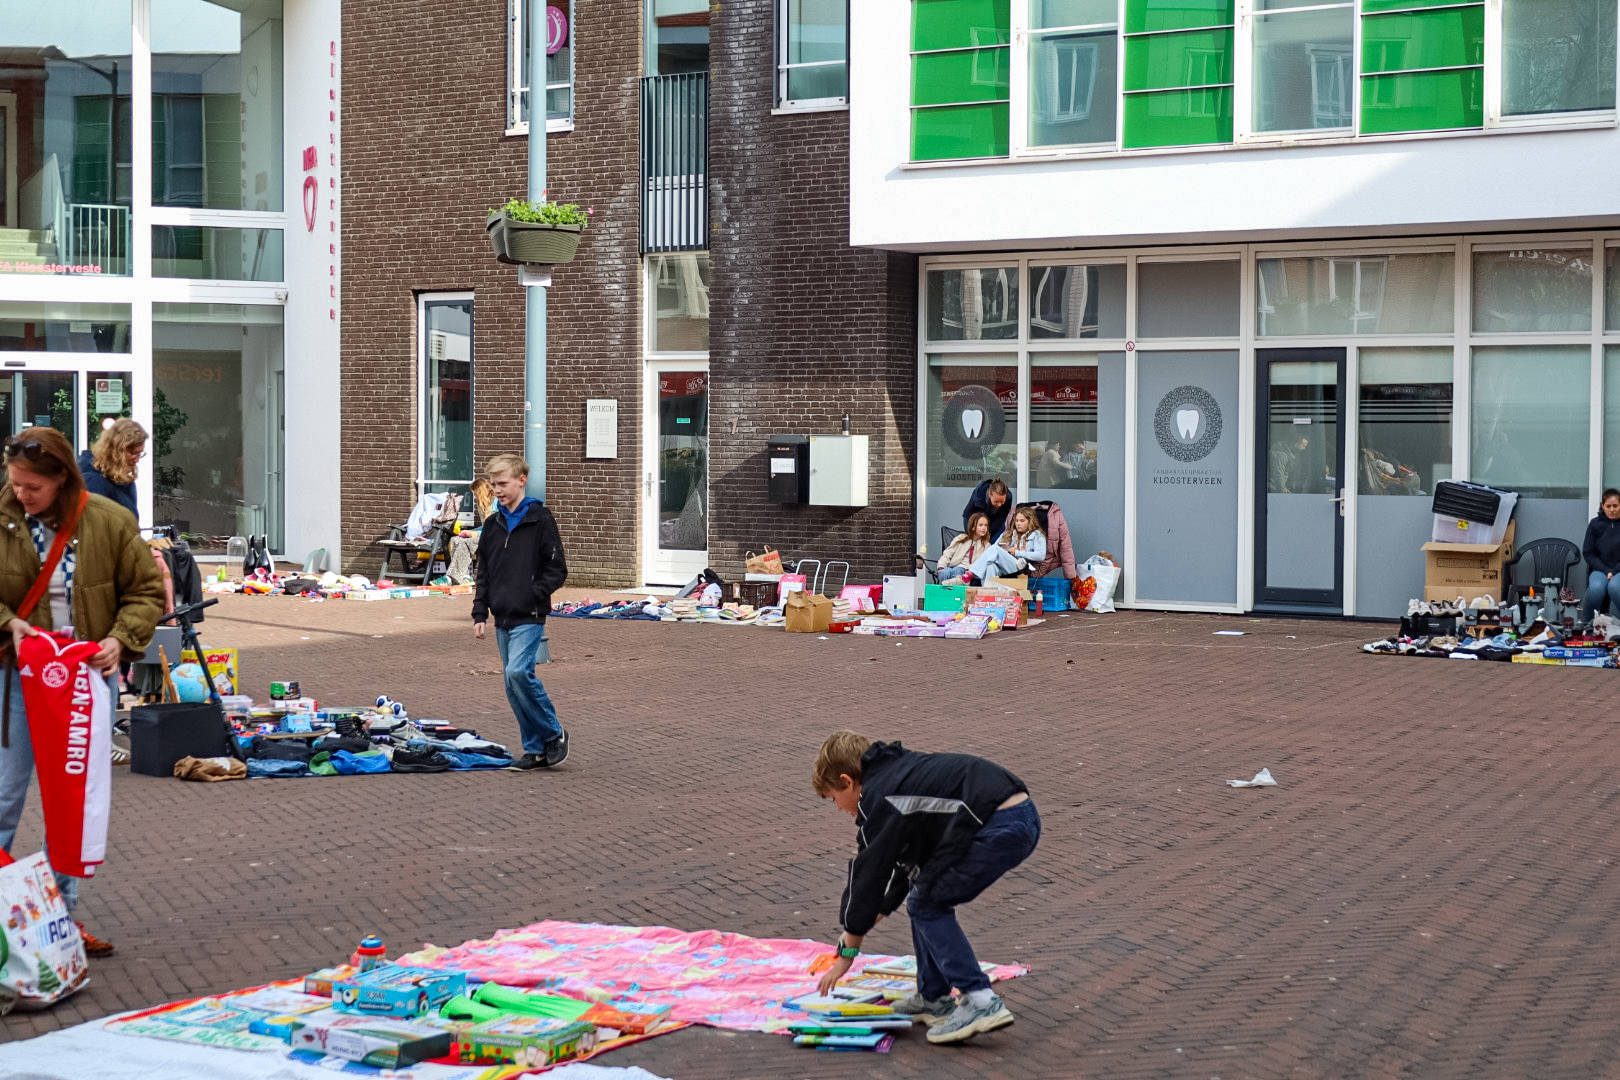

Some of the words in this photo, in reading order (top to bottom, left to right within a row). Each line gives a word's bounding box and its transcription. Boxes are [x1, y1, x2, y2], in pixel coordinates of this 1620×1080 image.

[16, 262, 101, 273] Kloosterveste
[589, 404, 615, 413] WELKOM
[1153, 476, 1223, 485] KLOOSTERVEEN
